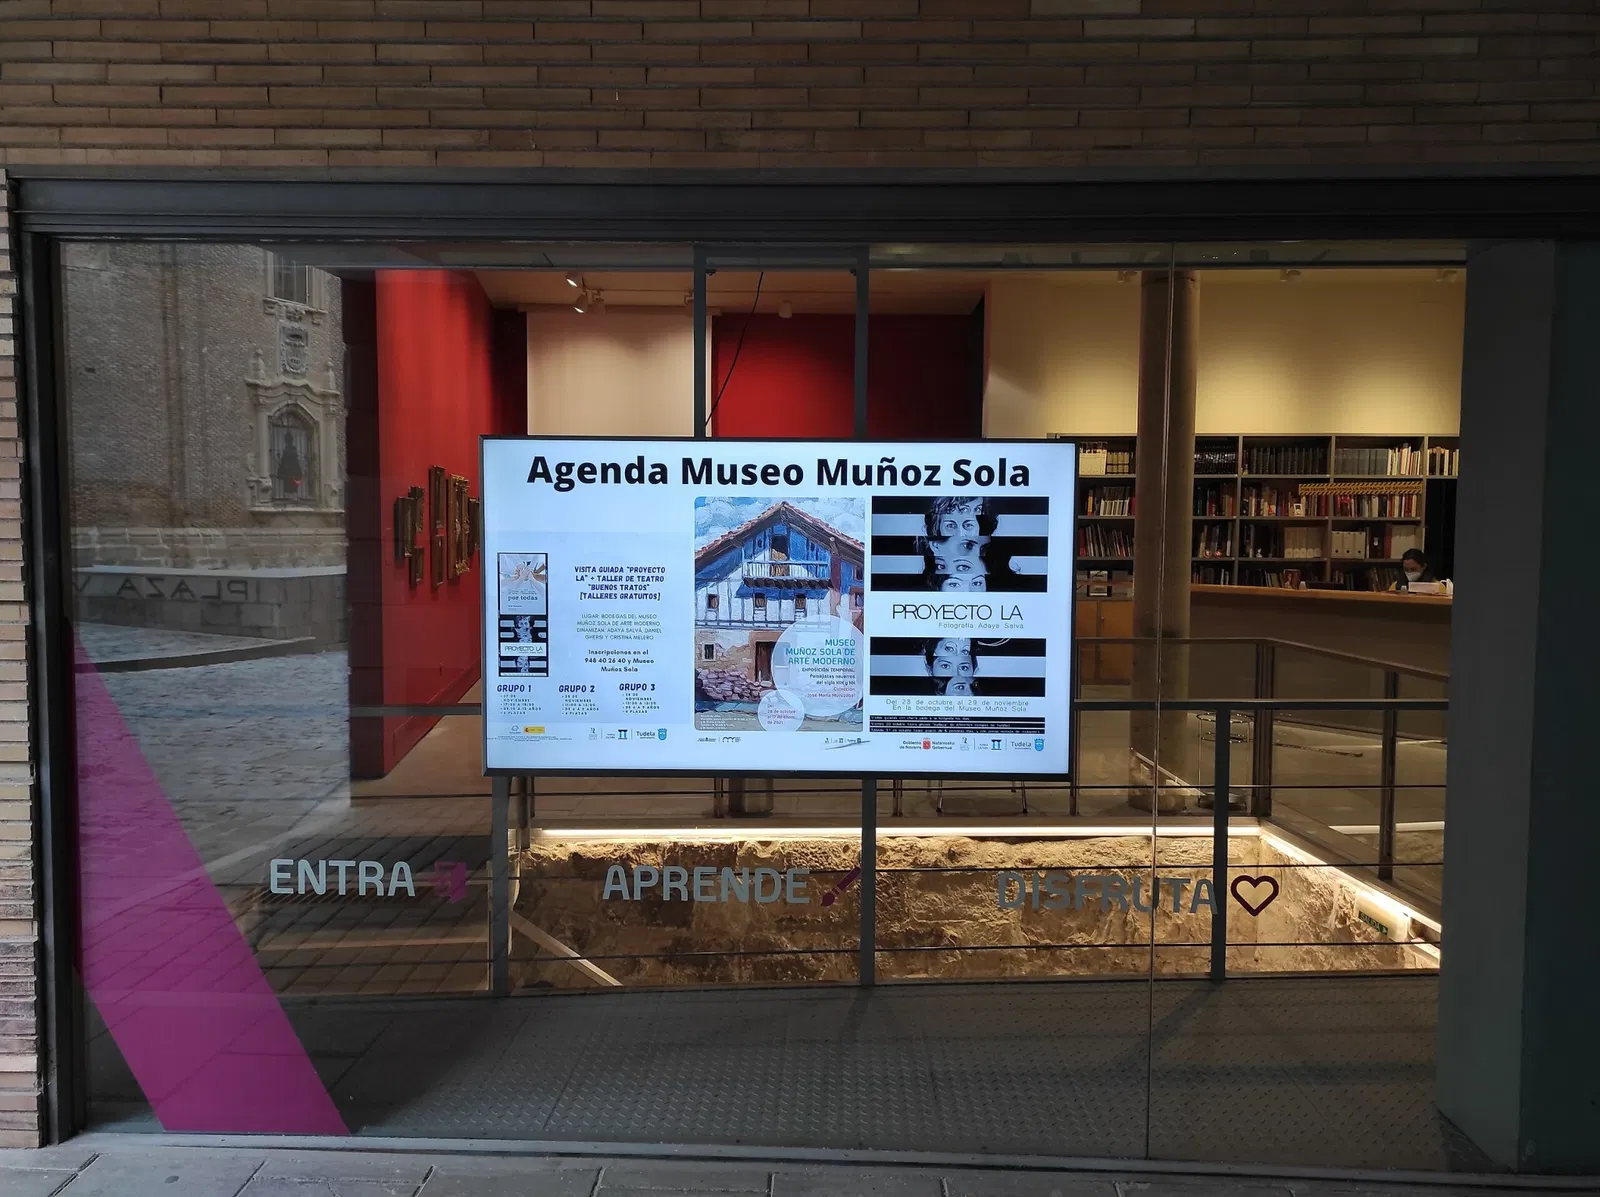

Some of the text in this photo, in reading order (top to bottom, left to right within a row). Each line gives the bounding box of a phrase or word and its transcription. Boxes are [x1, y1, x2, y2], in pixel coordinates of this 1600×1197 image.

[526, 455, 1030, 492] Agenda Museo Muñoz Sola
[893, 604, 1023, 620] PROYECTO LA
[786, 647, 817, 655] MUÑOZ
[270, 858, 416, 897] ENTRA
[602, 865, 810, 904] APRENDE
[998, 871, 1218, 915] DISFRUTA
